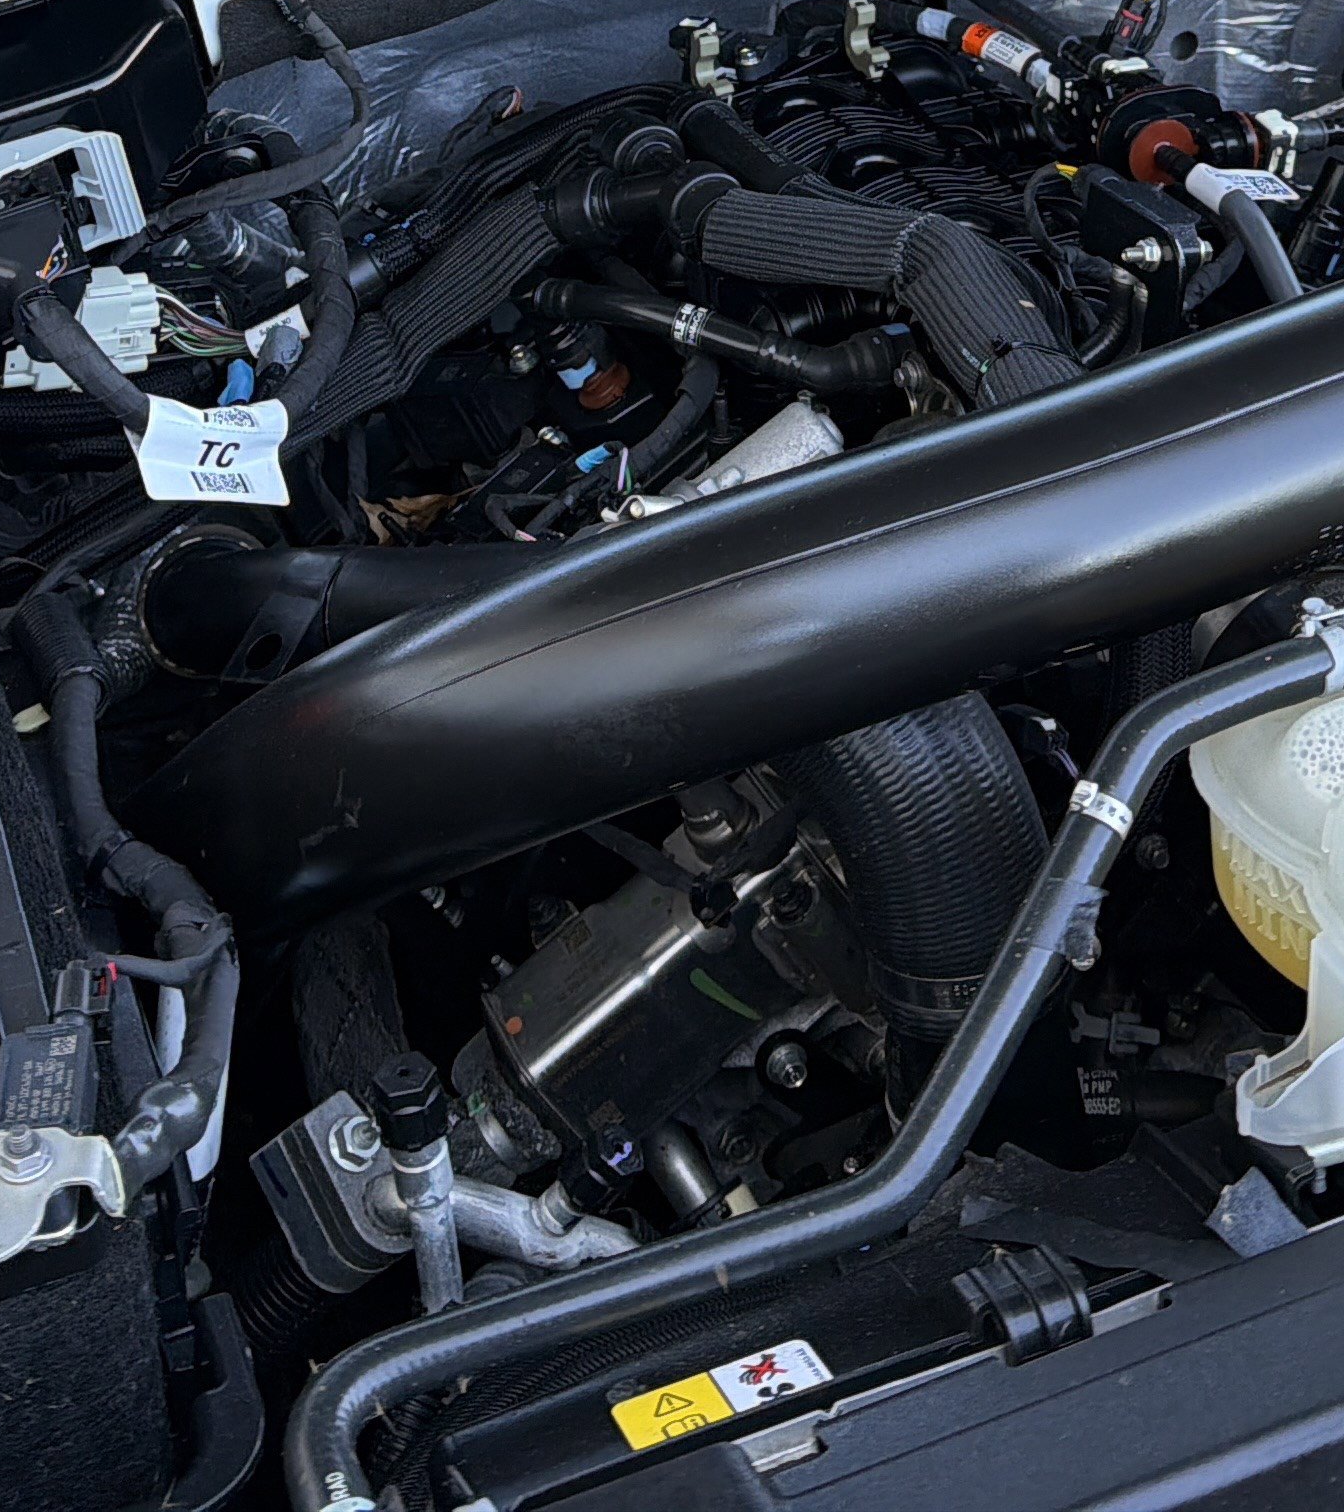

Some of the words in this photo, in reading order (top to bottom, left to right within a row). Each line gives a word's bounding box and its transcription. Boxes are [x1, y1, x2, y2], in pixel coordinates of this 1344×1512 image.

[198, 439, 240, 468] TC
[1232, 874, 1310, 962] MIN
[324, 1471, 351, 1502] RAD
